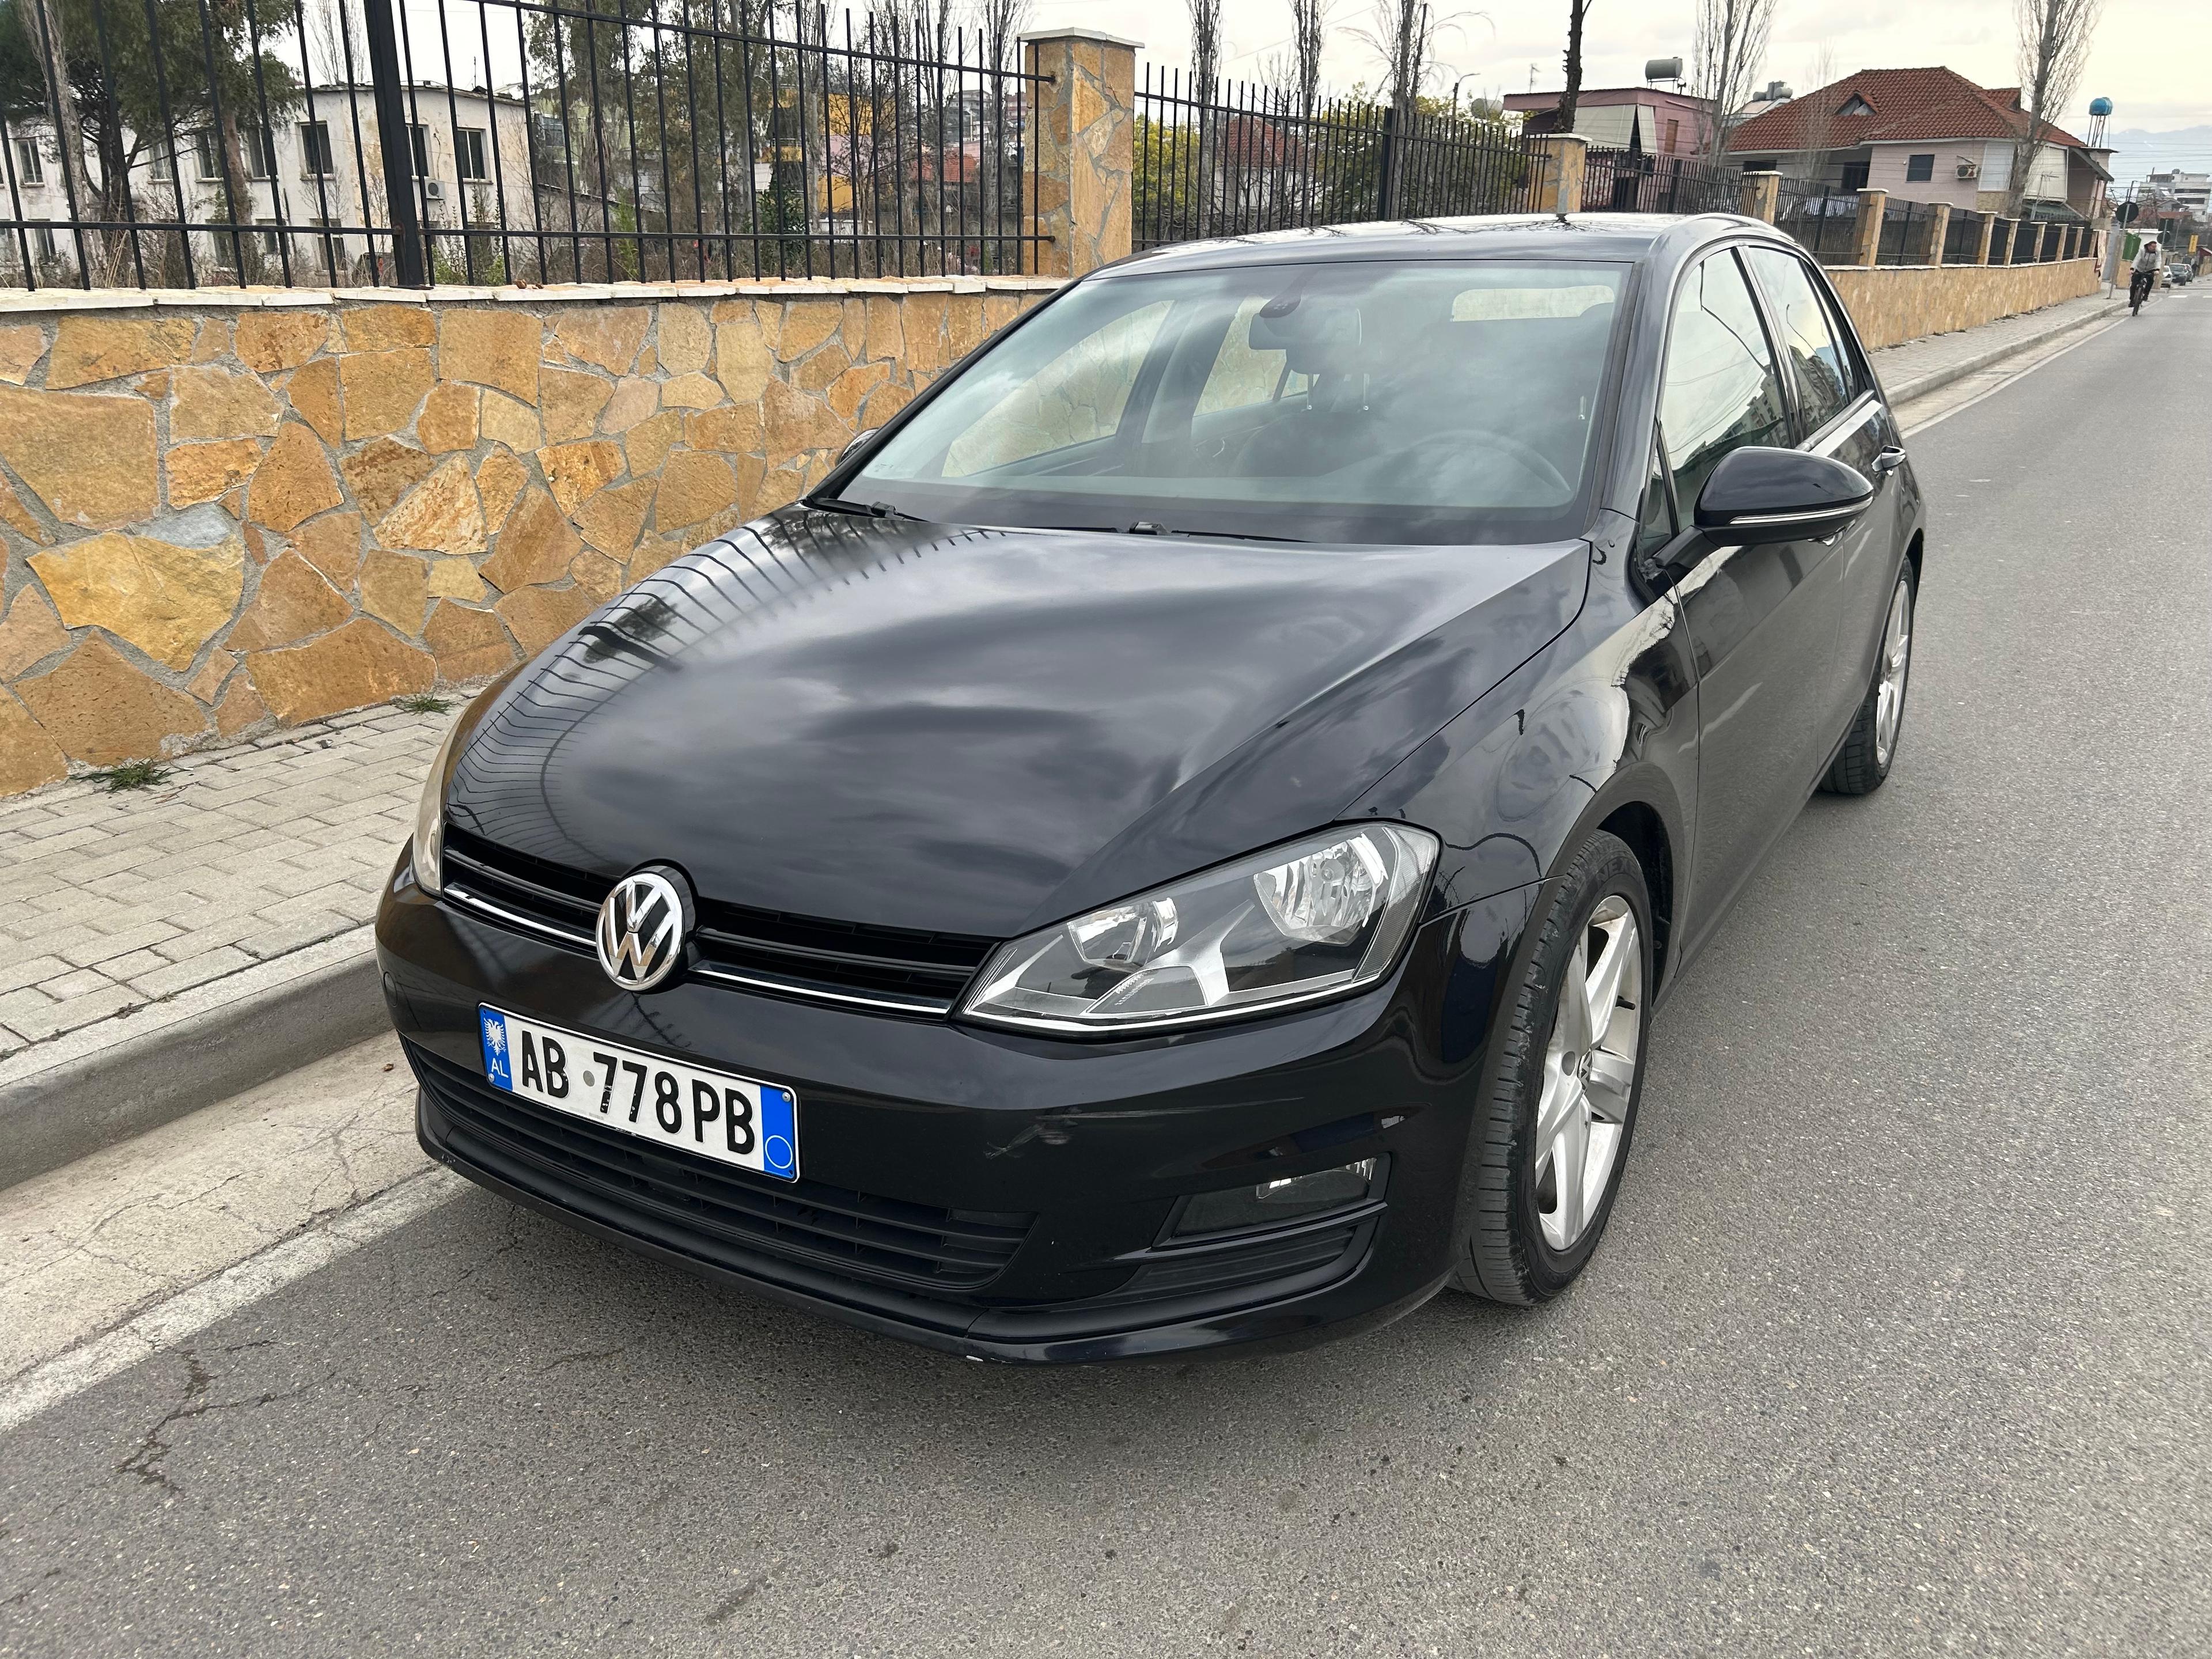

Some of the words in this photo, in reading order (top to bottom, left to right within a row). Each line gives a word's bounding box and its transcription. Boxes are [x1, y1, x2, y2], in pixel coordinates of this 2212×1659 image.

[596, 873, 684, 991] VW
[491, 1058, 509, 1078] AL
[522, 1031, 569, 1099] AB
[593, 1052, 683, 1134] 778
[692, 1078, 756, 1155] PB
